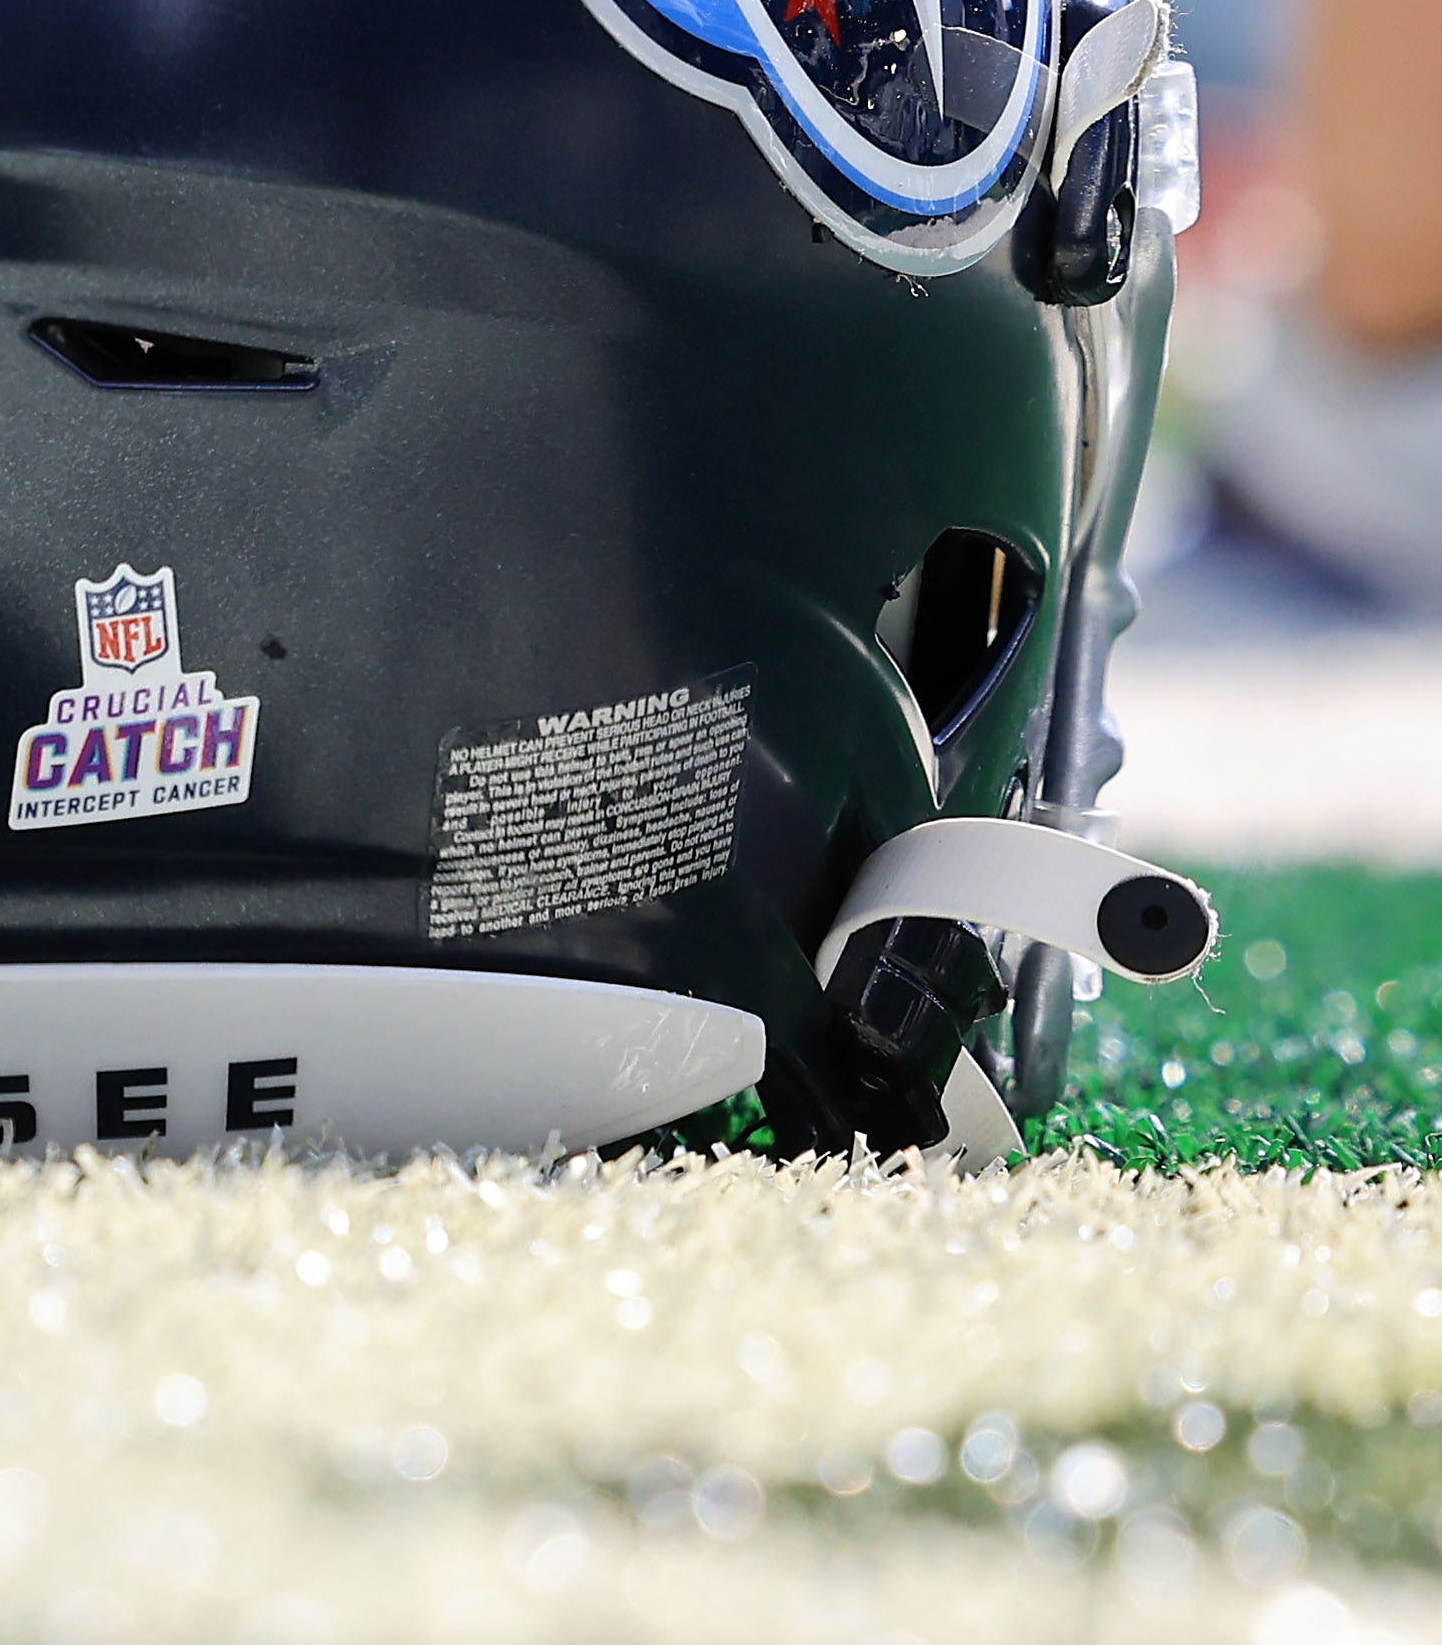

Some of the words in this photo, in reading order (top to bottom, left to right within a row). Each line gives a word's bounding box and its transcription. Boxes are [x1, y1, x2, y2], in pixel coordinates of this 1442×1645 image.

[95, 616, 164, 662] NFL
[57, 679, 213, 723] CRUCIAL
[470, 742, 517, 759] HELMET
[545, 729, 594, 748] PREVENT
[596, 719, 641, 739] SERIOUS
[643, 711, 670, 728] HEAD
[687, 698, 711, 716] NECK
[712, 685, 751, 708] INJURIES
[537, 688, 689, 735] WARNING
[25, 705, 250, 789] CATCH
[459, 758, 503, 774] PLAYER
[505, 753, 539, 768] MIGHT
[540, 744, 586, 763] RECEIVE
[587, 737, 619, 754] WHILE
[620, 719, 688, 746] PARTICIPATING
[700, 700, 745, 725] FOOTBALL.
[16, 790, 140, 820] INTERCEPT
[153, 775, 240, 806] CANCER
[439, 843, 475, 858] which
[498, 834, 537, 850] helmet
[564, 819, 608, 841] prevent.
[616, 803, 667, 829] Symptoms
[671, 792, 706, 811] include:
[710, 784, 728, 798] loss
[606, 781, 699, 816] CONCUSSION-BRAIN
[701, 771, 730, 789] INJURY
[530, 858, 555, 871] have
[557, 846, 610, 869] symptoms,
[612, 831, 666, 857] immediately
[668, 824, 687, 841] stop
[688, 814, 717, 835] playing
[544, 838, 589, 859] memory,
[593, 824, 642, 849] dizziness,
[646, 810, 692, 835] headache,
[696, 800, 725, 817] nausea
[431, 884, 468, 899] report
[470, 880, 498, 892] them
[539, 867, 574, 885] coach,
[577, 859, 609, 874] trainer
[630, 844, 667, 864] parents.
[700, 826, 724, 841] return
[481, 898, 533, 917] MEDICAL
[536, 884, 611, 907] CLEARANCE.
[618, 873, 656, 894] Ignoring
[660, 868, 675, 880] this
[678, 856, 710, 877] warning
[581, 867, 632, 889] symptoms
[652, 857, 674, 873] gone
[713, 836, 731, 849] have
[479, 914, 523, 930] another
[555, 905, 581, 917] more
[588, 894, 627, 910] serious
[649, 881, 672, 896] fatal
[675, 873, 697, 888] brain
[702, 864, 727, 883] injury.
